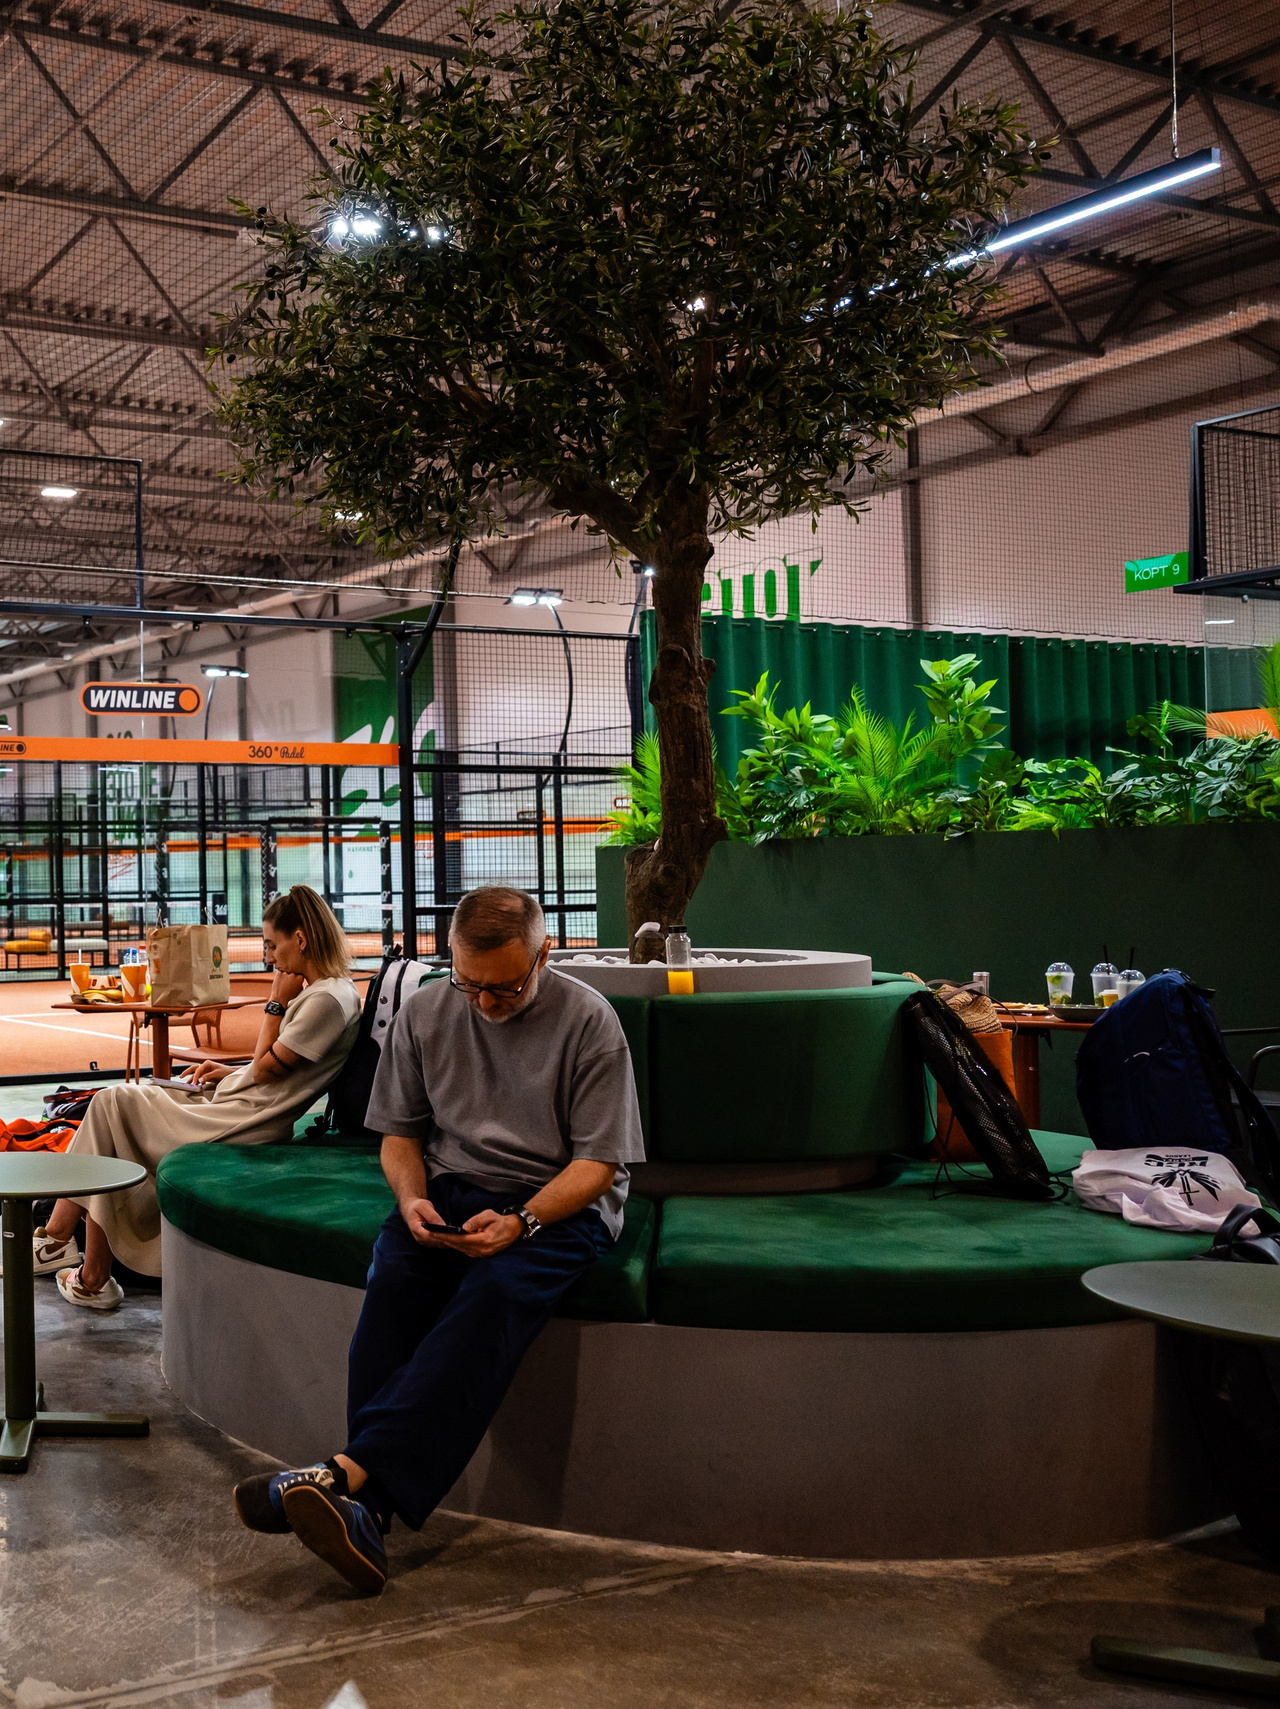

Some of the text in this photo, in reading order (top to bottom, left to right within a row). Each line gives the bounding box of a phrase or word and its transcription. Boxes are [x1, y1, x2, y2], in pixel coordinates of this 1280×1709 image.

[1134, 563, 1180, 581] КОРТ 9
[89, 689, 176, 709] WINLINE
[280, 746, 305, 759] Padel
